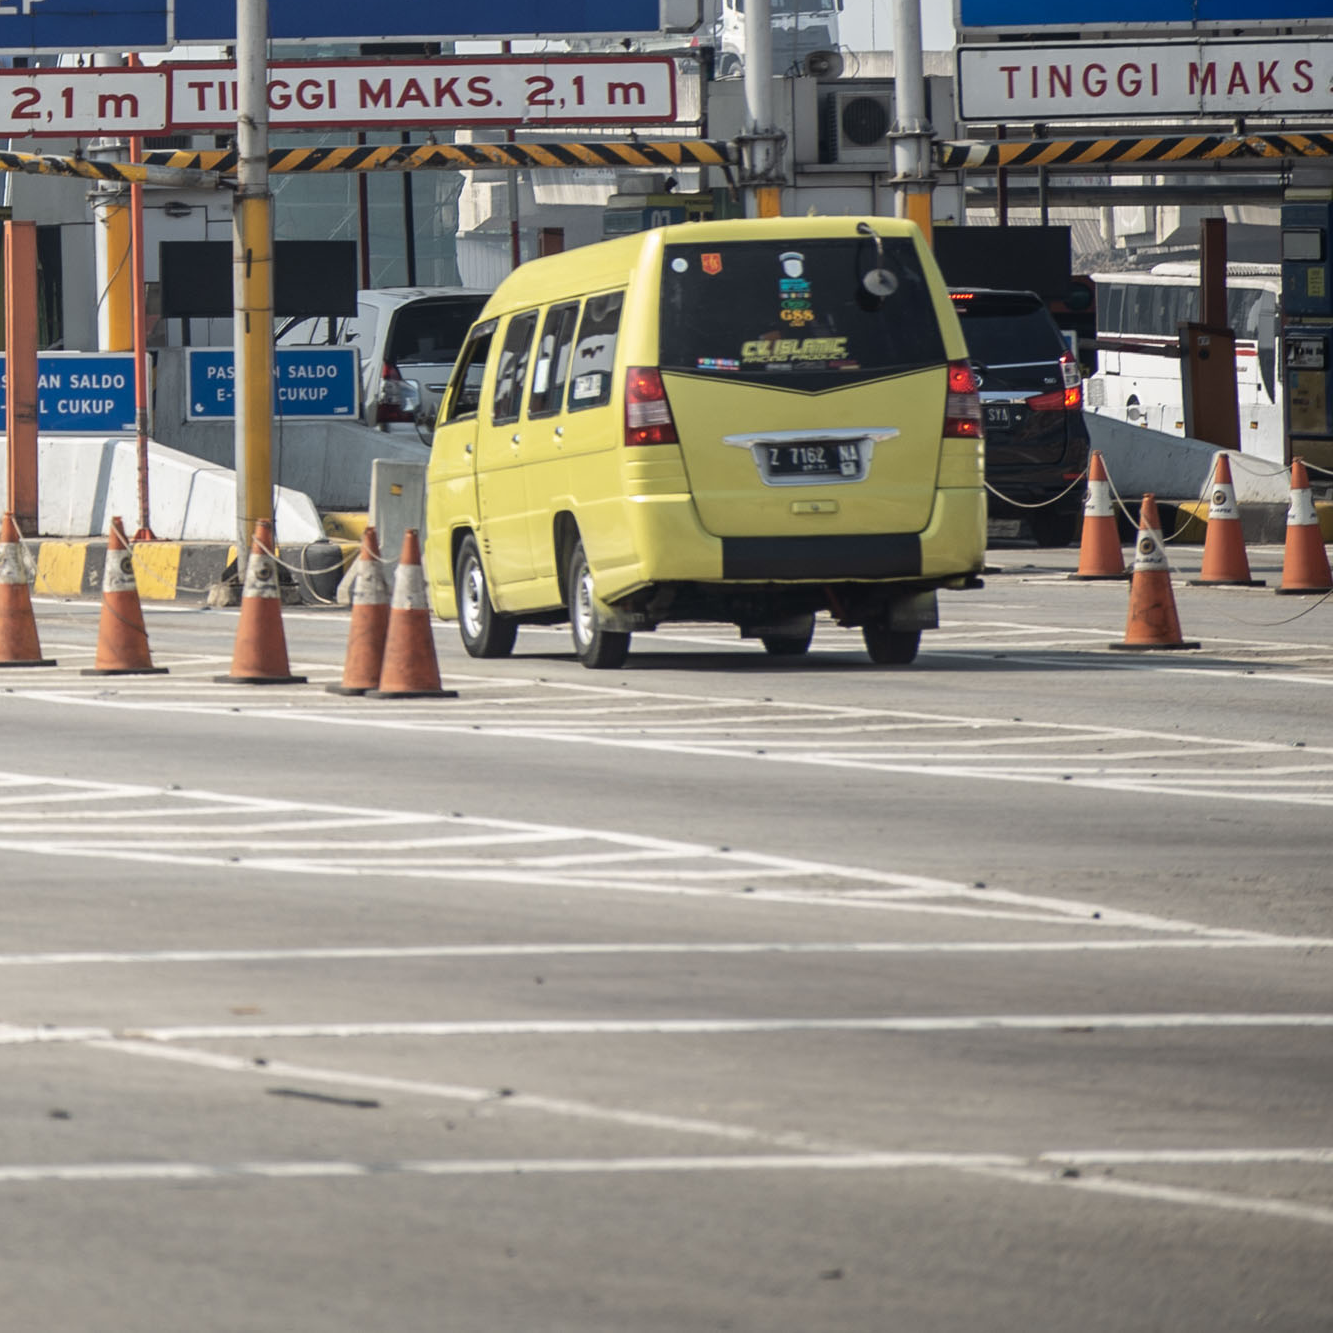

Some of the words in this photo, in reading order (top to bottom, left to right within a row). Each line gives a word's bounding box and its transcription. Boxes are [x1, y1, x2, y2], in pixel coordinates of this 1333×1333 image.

[999, 62, 1160, 100] TINGGI
[188, 78, 335, 112] TIGGI
[358, 76, 503, 109] MAKS.
[525, 75, 586, 109] 2,1
[606, 80, 647, 106] m
[11, 86, 74, 124] 2,1
[97, 90, 140, 119] m
[287, 364, 338, 379] SALDO
[69, 374, 126, 389] SALDO
[278, 387, 330, 401] CUKUP
[57, 399, 116, 414] CUKUP
[789, 447, 827, 465] 7162
